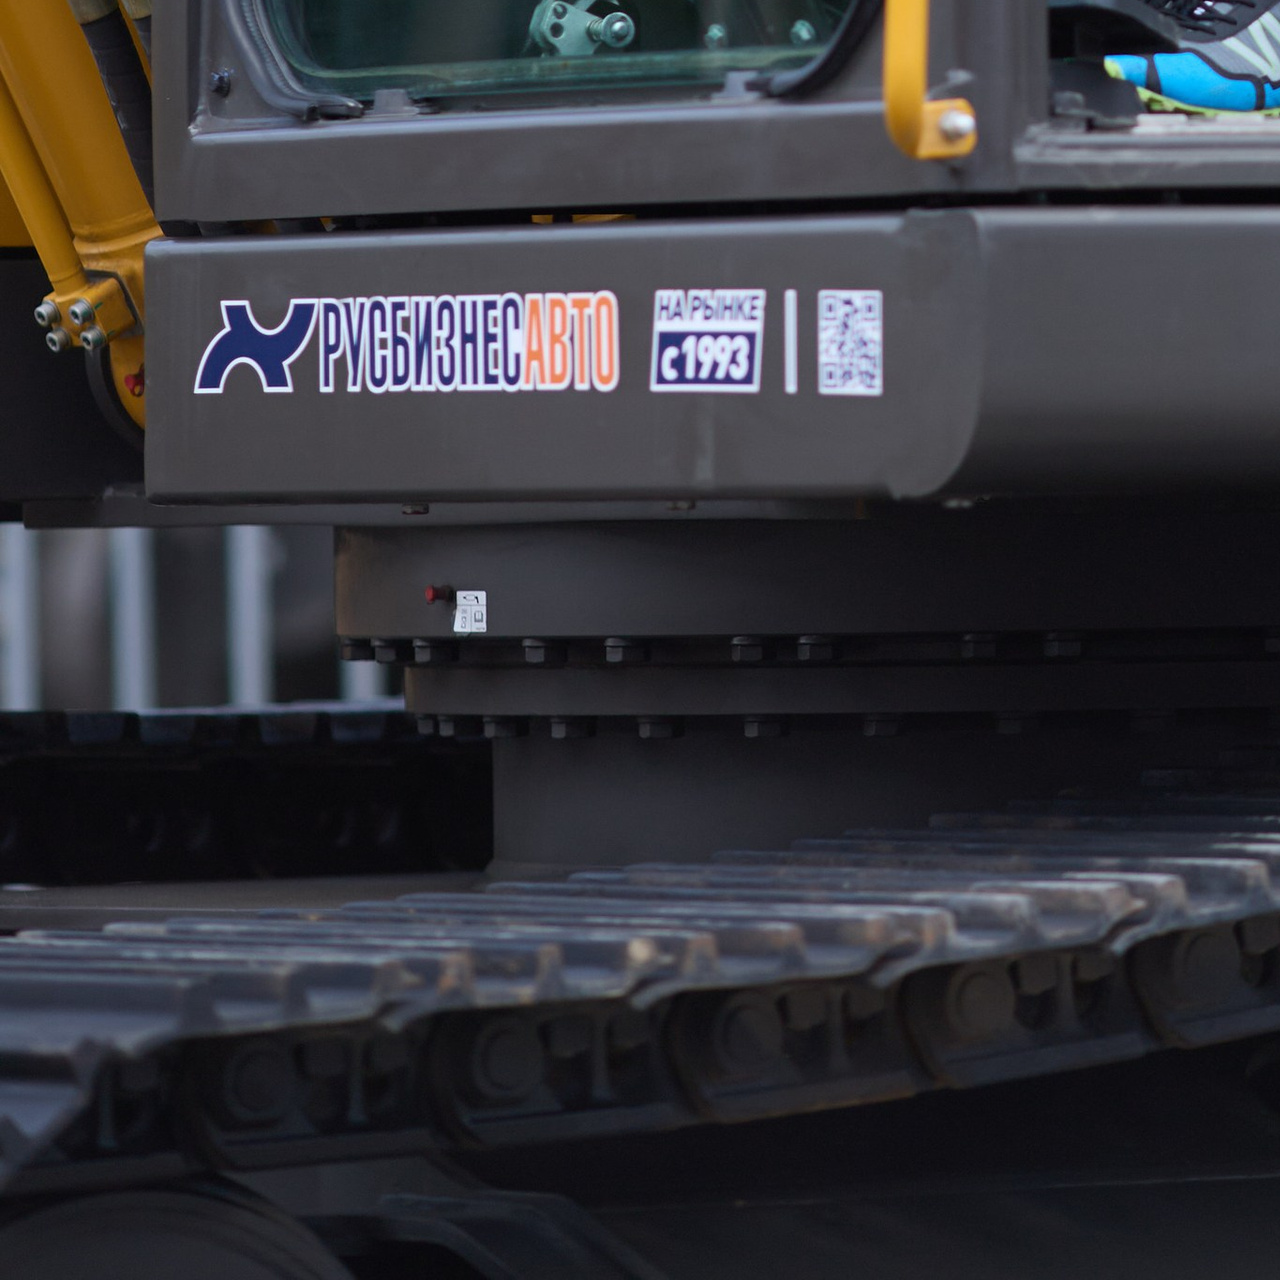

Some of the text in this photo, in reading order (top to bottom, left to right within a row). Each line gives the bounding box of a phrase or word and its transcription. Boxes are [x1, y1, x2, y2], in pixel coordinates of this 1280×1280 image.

[657, 296, 762, 321] НА РЫНКЕ
[319, 291, 619, 392] РУСБИЗНЕСАВТО
